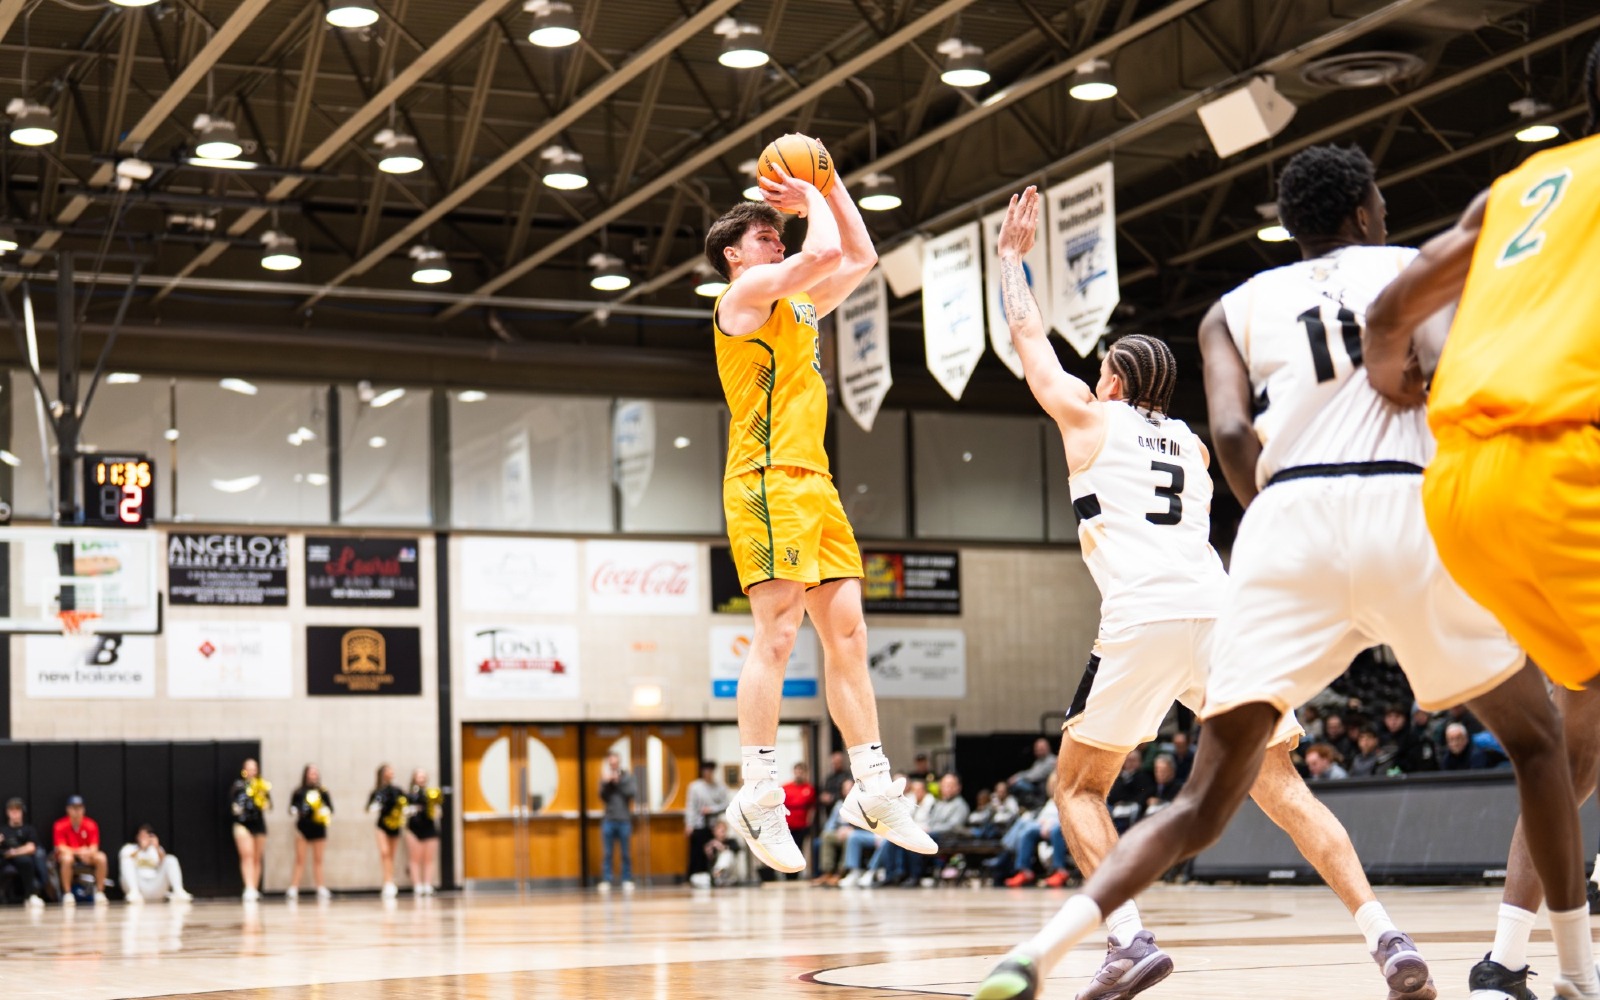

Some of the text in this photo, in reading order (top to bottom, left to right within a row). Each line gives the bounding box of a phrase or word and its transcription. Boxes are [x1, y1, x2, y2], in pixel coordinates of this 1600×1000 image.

[1496, 168, 1572, 268] 2
[1138, 436, 1180, 456] DAVIS III
[120, 485, 142, 523] 2
[1145, 460, 1185, 526] 3
[169, 535, 288, 558] ANGELO'S
[38, 669, 142, 683] new balance
